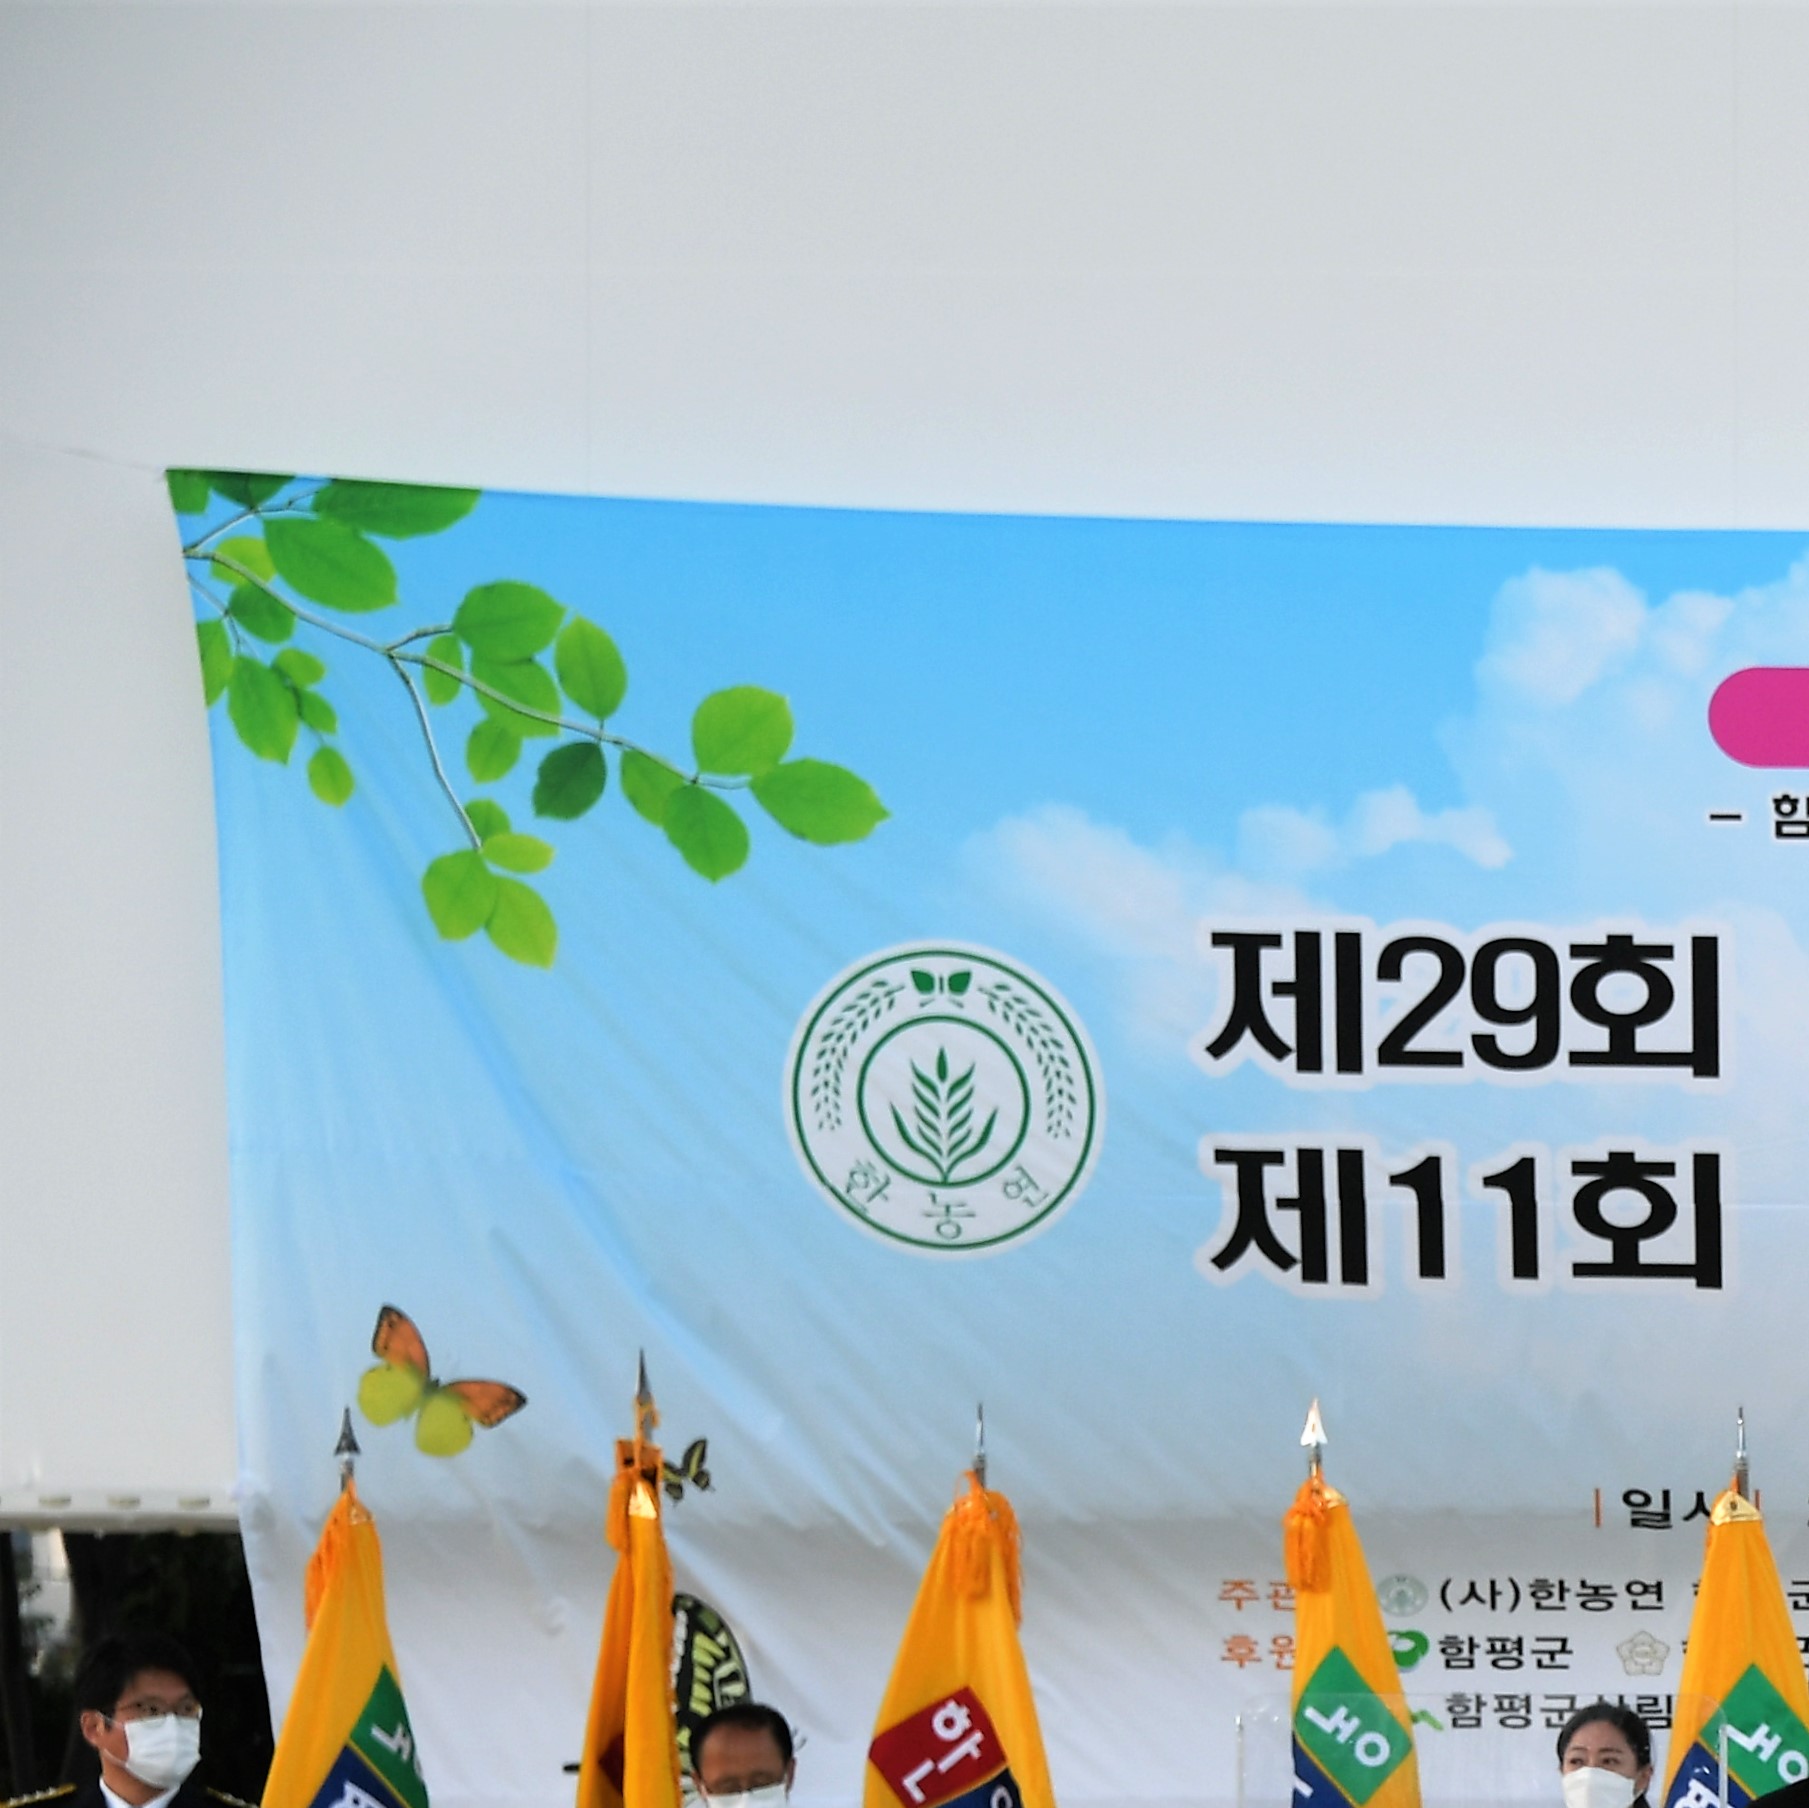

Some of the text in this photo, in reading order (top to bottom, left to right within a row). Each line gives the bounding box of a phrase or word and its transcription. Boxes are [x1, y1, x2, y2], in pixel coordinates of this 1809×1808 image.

[1208, 920, 1720, 1080] 제29회
[1208, 1145, 1720, 1291] 제11회
[1439, 1575, 1663, 1613] (사)한농연
[1439, 1633, 1574, 1670] 함평군
